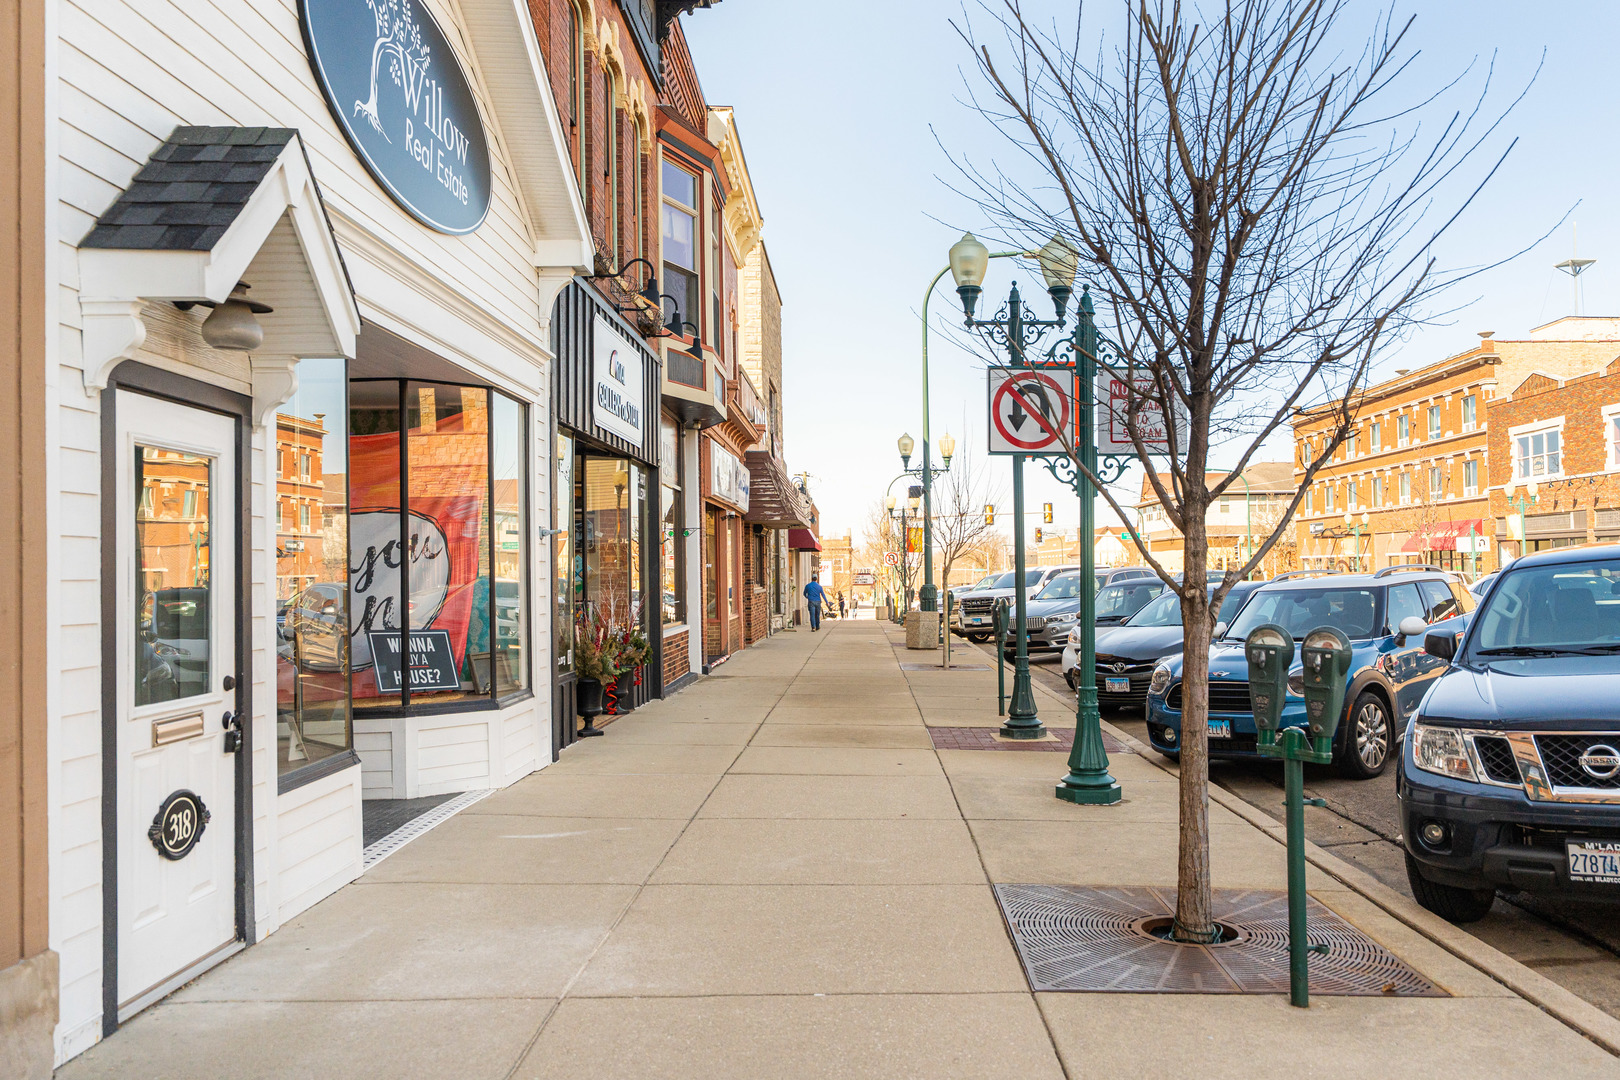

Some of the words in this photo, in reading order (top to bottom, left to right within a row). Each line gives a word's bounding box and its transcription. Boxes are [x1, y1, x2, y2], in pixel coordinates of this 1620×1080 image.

[398, 44, 469, 166] Willow
[405, 117, 433, 173] Real
[437, 148, 468, 206] Estate
[1136, 414, 1148, 425] TO
[387, 637, 435, 653] WNNA
[421, 653, 429, 665] A
[393, 669, 440, 685] HUSE?
[1208, 725, 1223, 734] ELLY
[1583, 757, 1618, 765] NISSAN
[169, 809, 191, 846] 318
[1571, 853, 1620, 875] 27874
